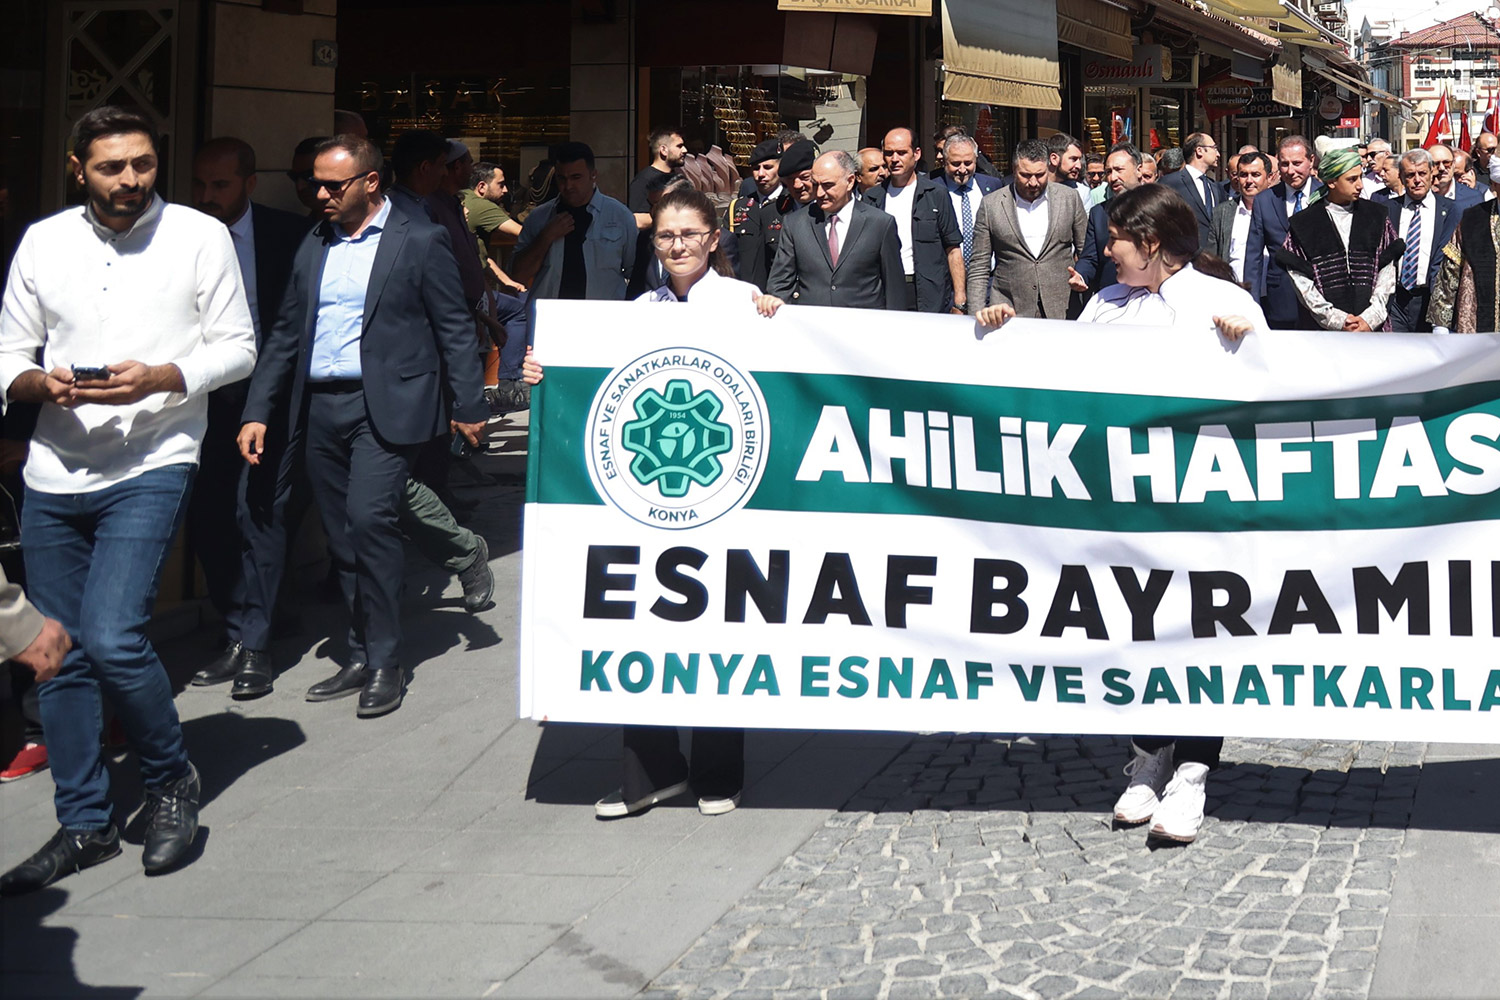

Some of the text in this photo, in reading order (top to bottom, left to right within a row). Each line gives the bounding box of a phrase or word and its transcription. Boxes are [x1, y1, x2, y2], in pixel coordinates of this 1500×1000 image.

[320, 48, 333, 60] 14
[599, 355, 758, 486] ESNAF VE SANATKARLAR ODALARI BİRLİĞİ
[648, 507, 699, 522] KONYA
[583, 545, 937, 629] ESNAF
[580, 650, 781, 696] KONYA
[801, 656, 994, 700] ESNAF
[1009, 664, 1086, 703] VE
